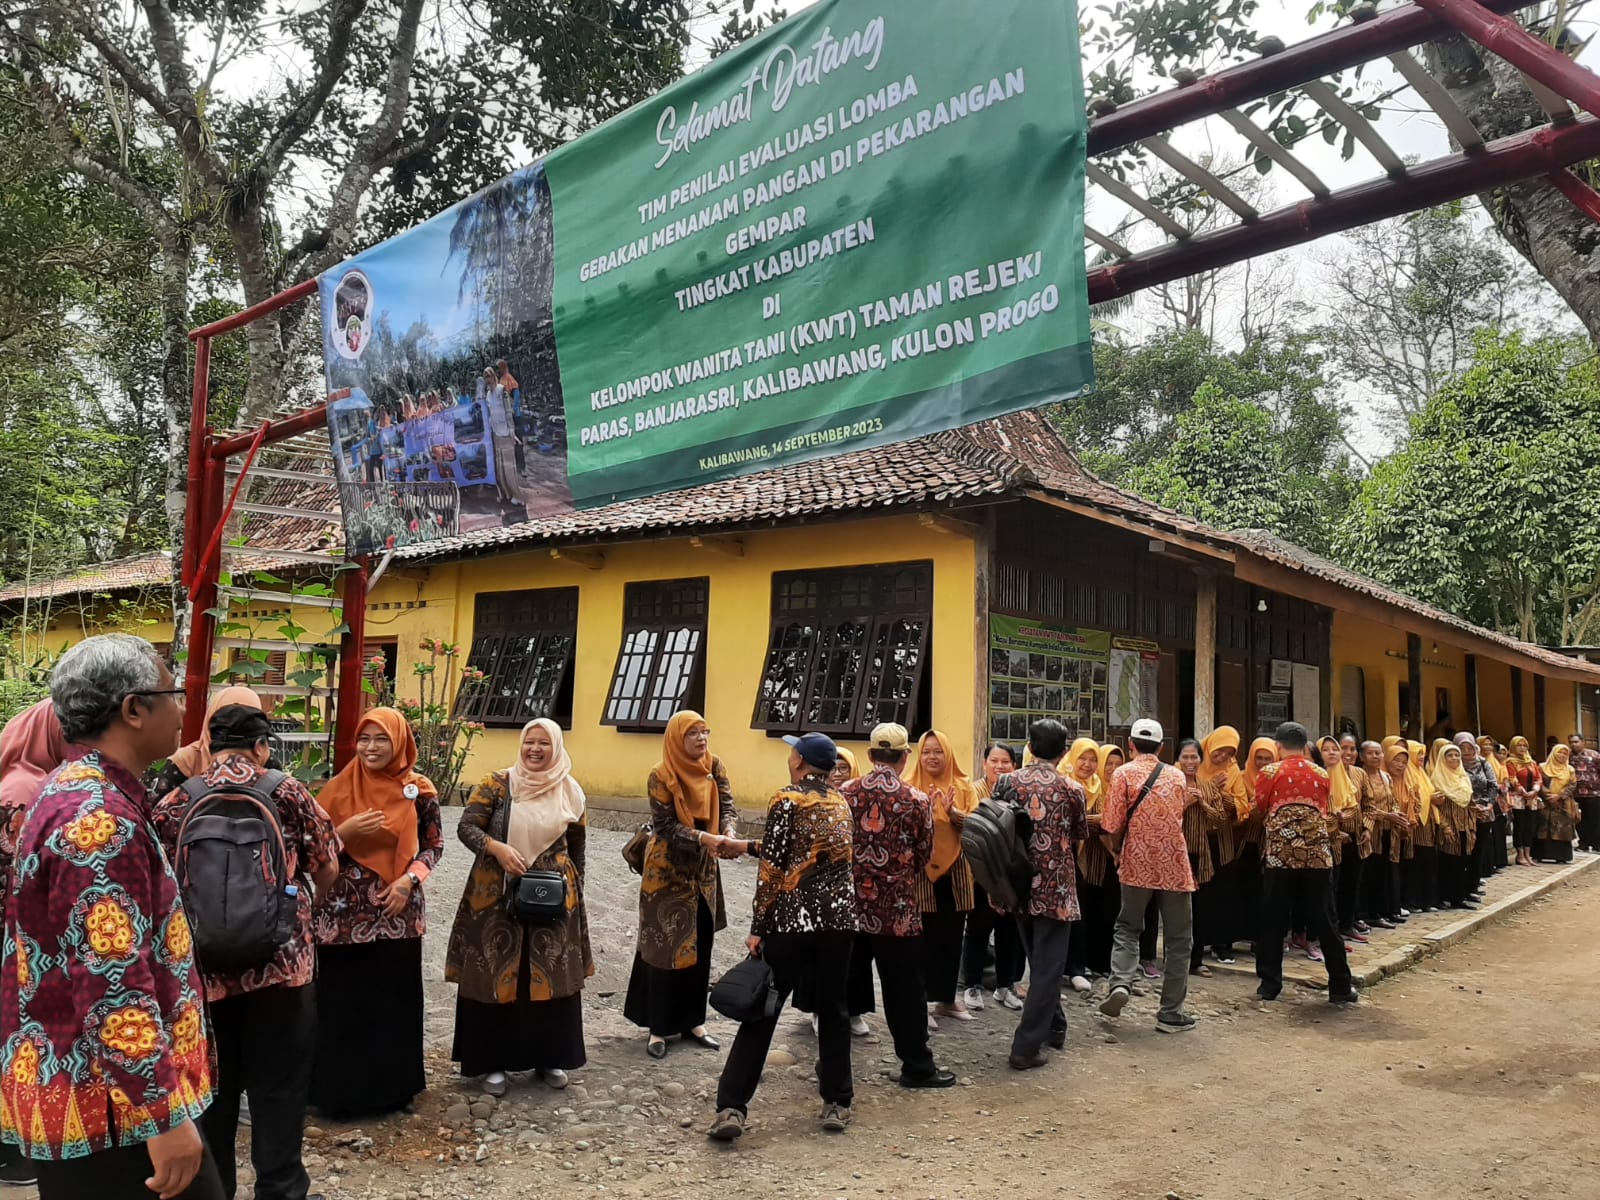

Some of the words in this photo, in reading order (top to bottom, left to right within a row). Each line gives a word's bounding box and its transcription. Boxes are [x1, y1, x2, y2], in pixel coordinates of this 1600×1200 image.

[638, 195, 666, 224] TIM
[670, 160, 734, 210] PENILAI
[739, 112, 834, 176] EVALUASI
[839, 74, 918, 131] LOMBA
[654, 67, 761, 169] Selamat
[762, 16, 884, 112] Datang
[579, 236, 648, 282] GERAKAN
[652, 194, 739, 250] MENANAM
[743, 156, 826, 211] PANGAN
[830, 145, 851, 175] DI
[857, 67, 1025, 163] PEKARANGAN
[725, 206, 806, 255] GEMPAR
[591, 368, 673, 411] KELOMPOK
[674, 347, 742, 385] WANITA
[744, 331, 785, 363] TANI
[790, 310, 856, 354] (KWT)
[859, 281, 942, 328] TAMAN
[948, 250, 1042, 301] REJEKI
[674, 265, 750, 312] TINGKAT
[753, 217, 875, 284] KABUPATEN
[762, 293, 781, 319] DI
[580, 416, 632, 446] PARAS,
[635, 385, 740, 432] BANJARASRI,
[743, 344, 886, 402] KALIBAWANG,
[891, 317, 974, 362] KULON
[980, 284, 1059, 338] PROGO
[699, 445, 771, 471] KALIBAWANG,
[771, 442, 783, 455] 14
[784, 425, 850, 451] SEPTEMBER
[852, 417, 883, 436] 2023
